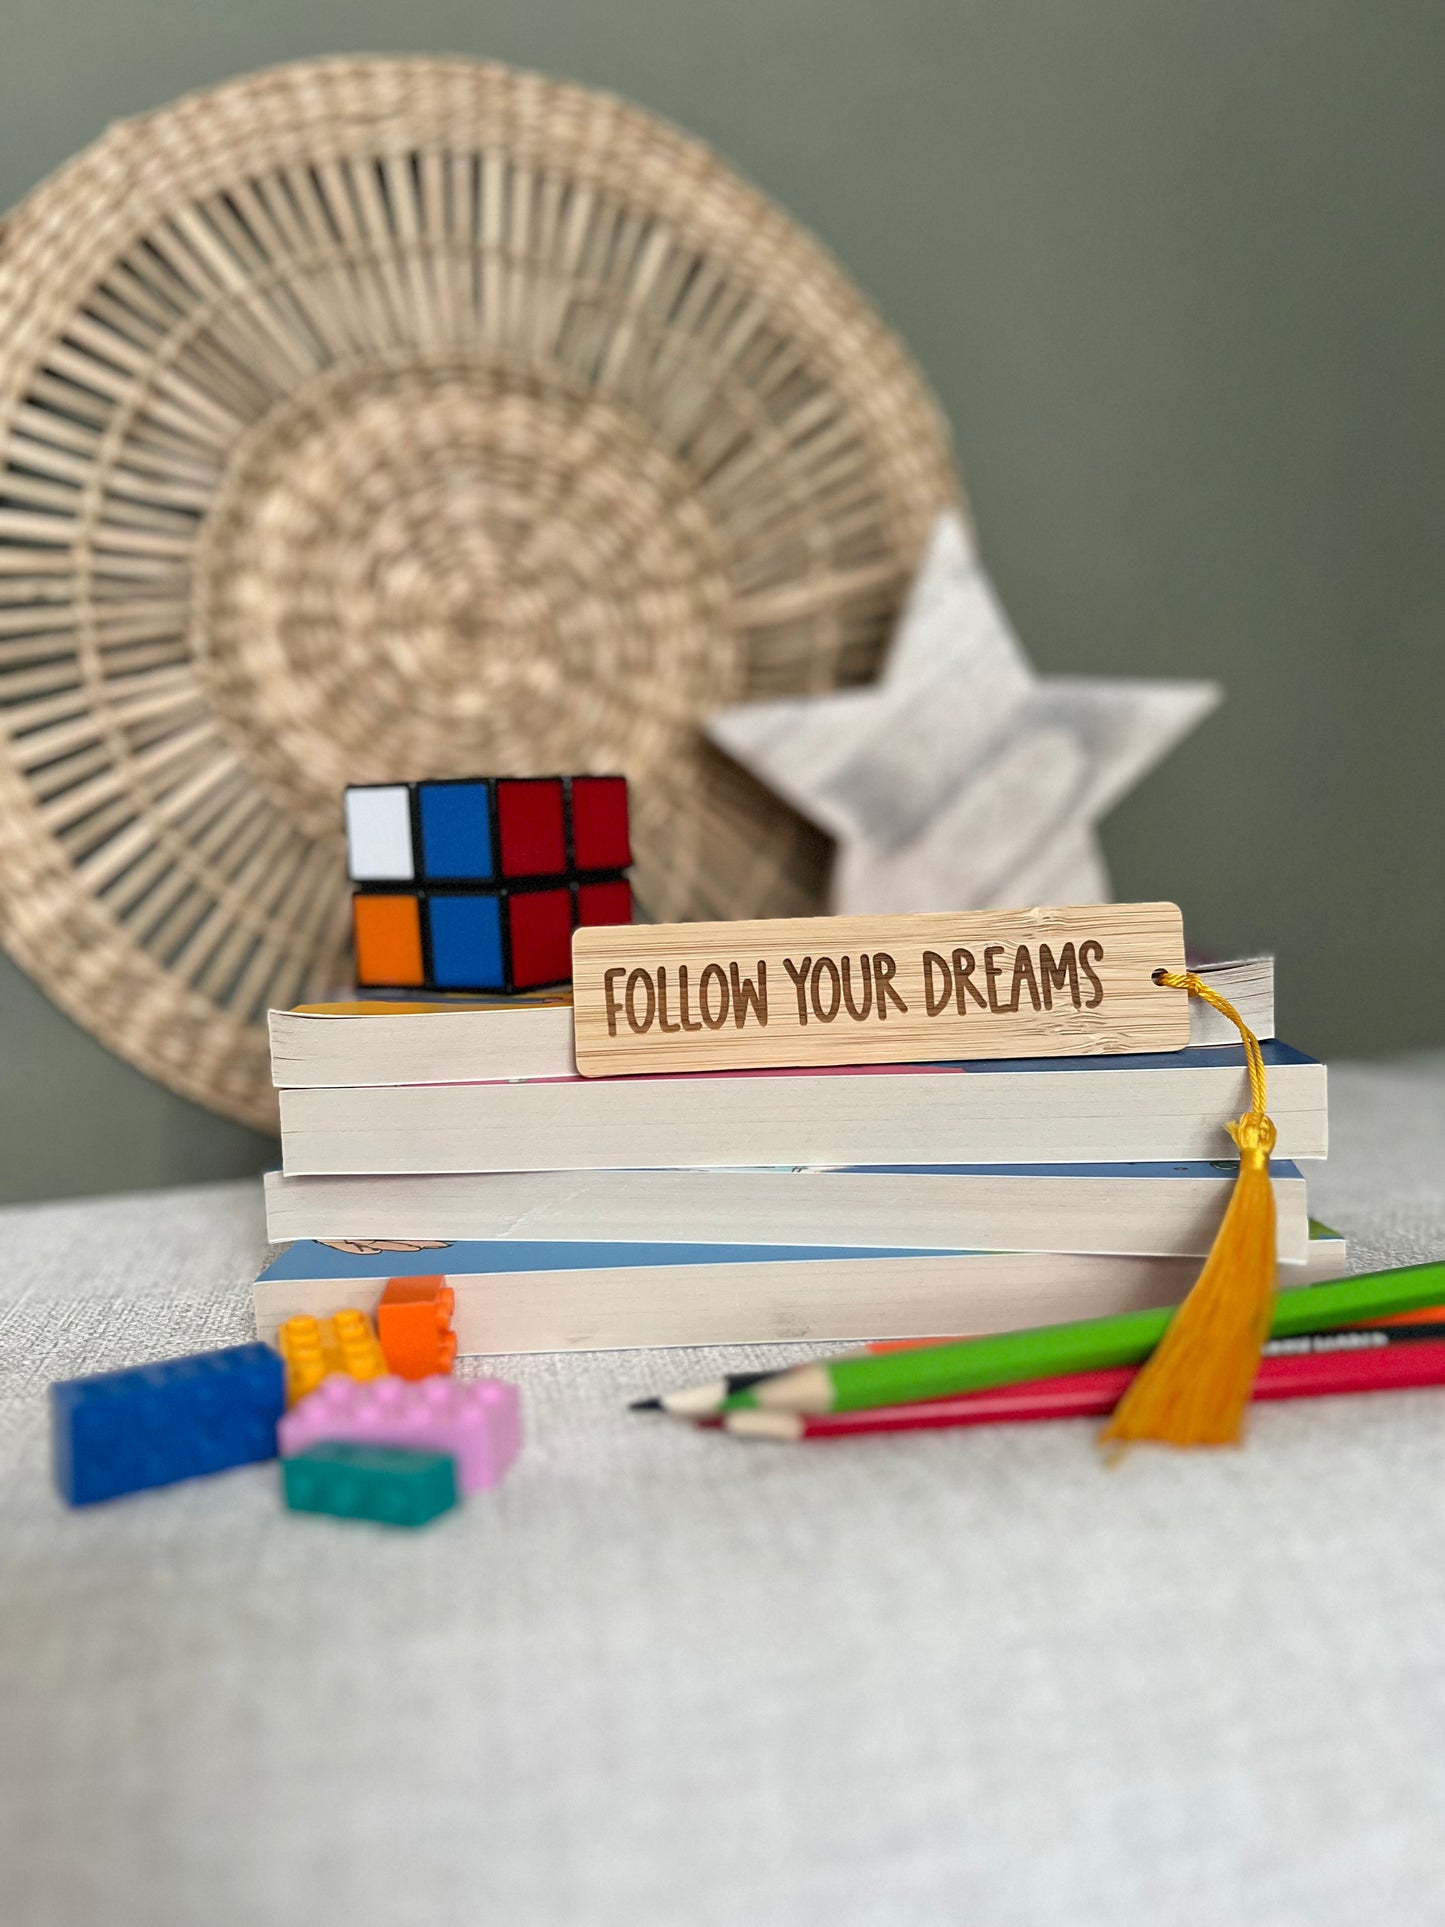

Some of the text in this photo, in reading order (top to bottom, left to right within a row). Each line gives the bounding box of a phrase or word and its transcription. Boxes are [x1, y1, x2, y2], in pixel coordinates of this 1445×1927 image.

[604, 939, 1104, 1037] FOLLOW YOUR DREAMS
